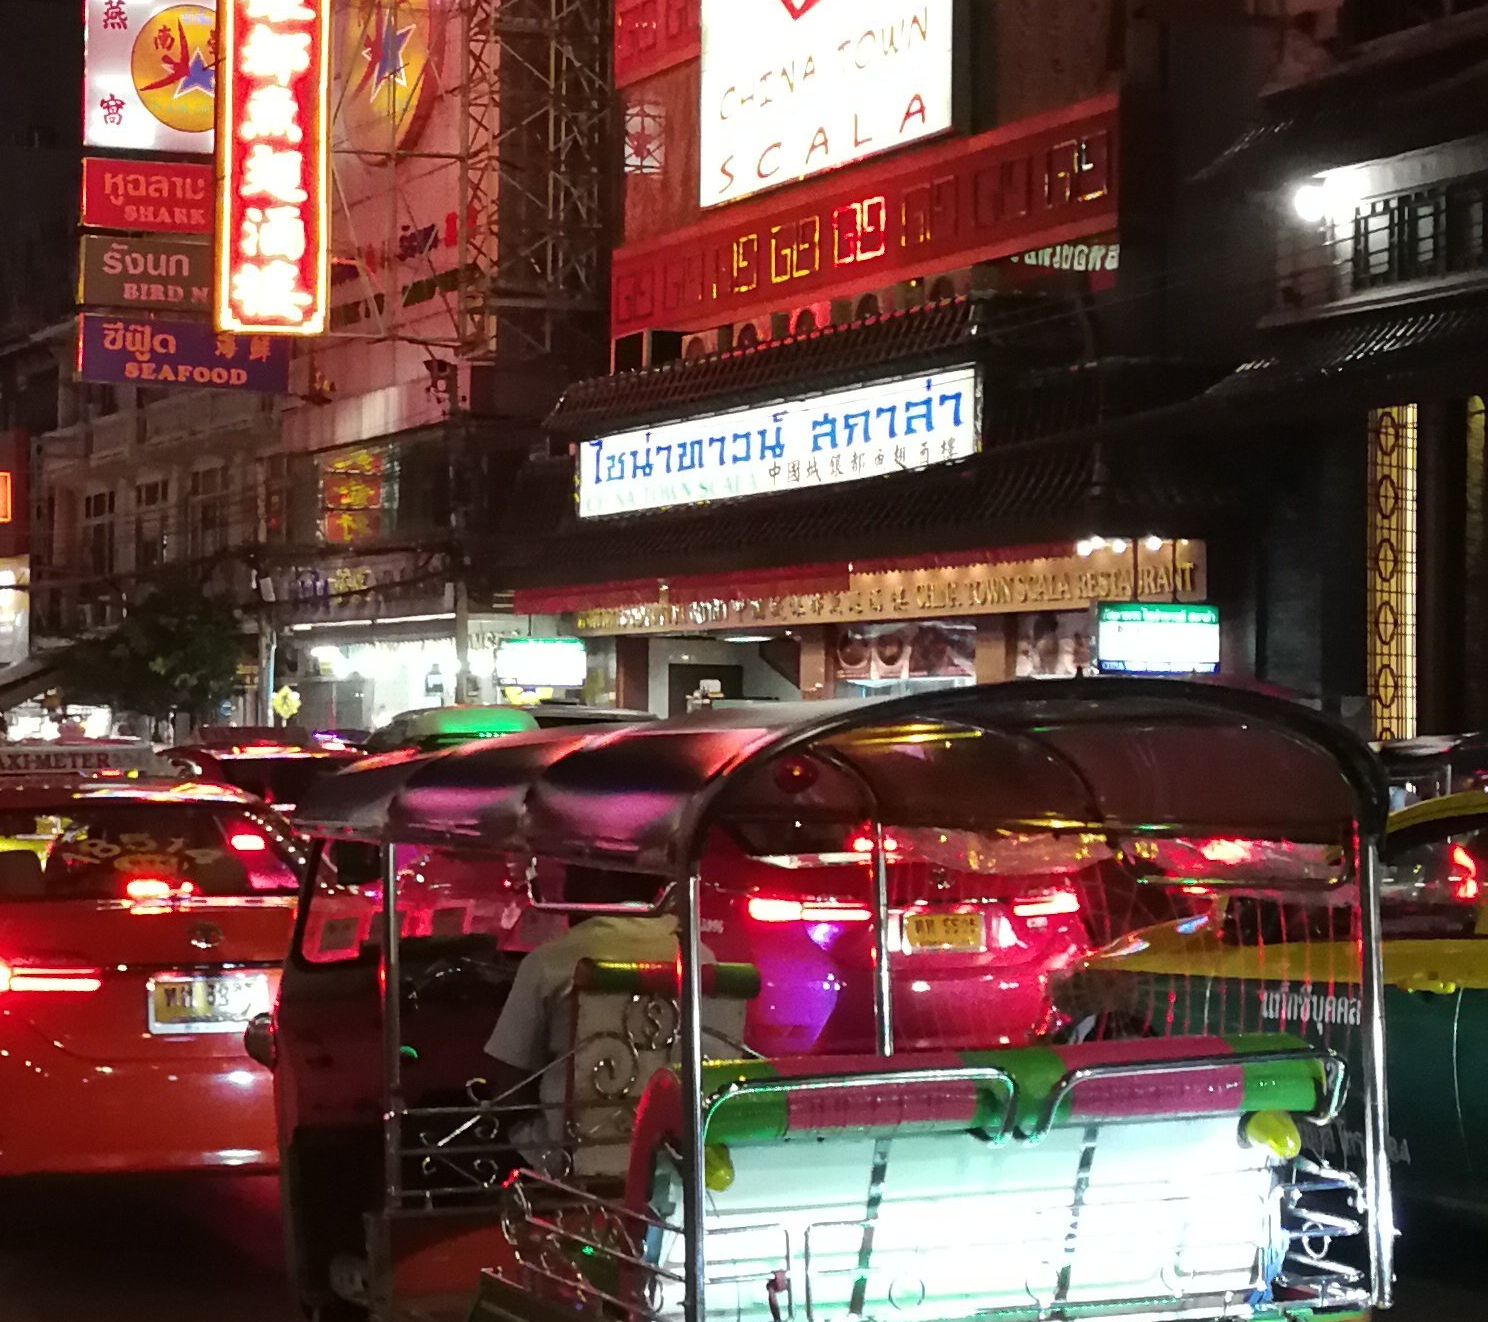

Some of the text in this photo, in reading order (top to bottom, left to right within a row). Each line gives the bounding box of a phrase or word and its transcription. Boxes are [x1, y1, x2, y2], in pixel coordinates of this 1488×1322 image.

[719, 6, 929, 121] CHINA TOWN
[718, 91, 927, 195] SCALA
[102, 242, 190, 277] รังนก
[123, 282, 185, 303] BIRD
[124, 361, 248, 386] SEAFOOD
[589, 378, 964, 485] ไชน่าทาวน์ สกาล่า
[965, 574, 1014, 607] TOWN
[1015, 571, 1070, 604] SCALA
